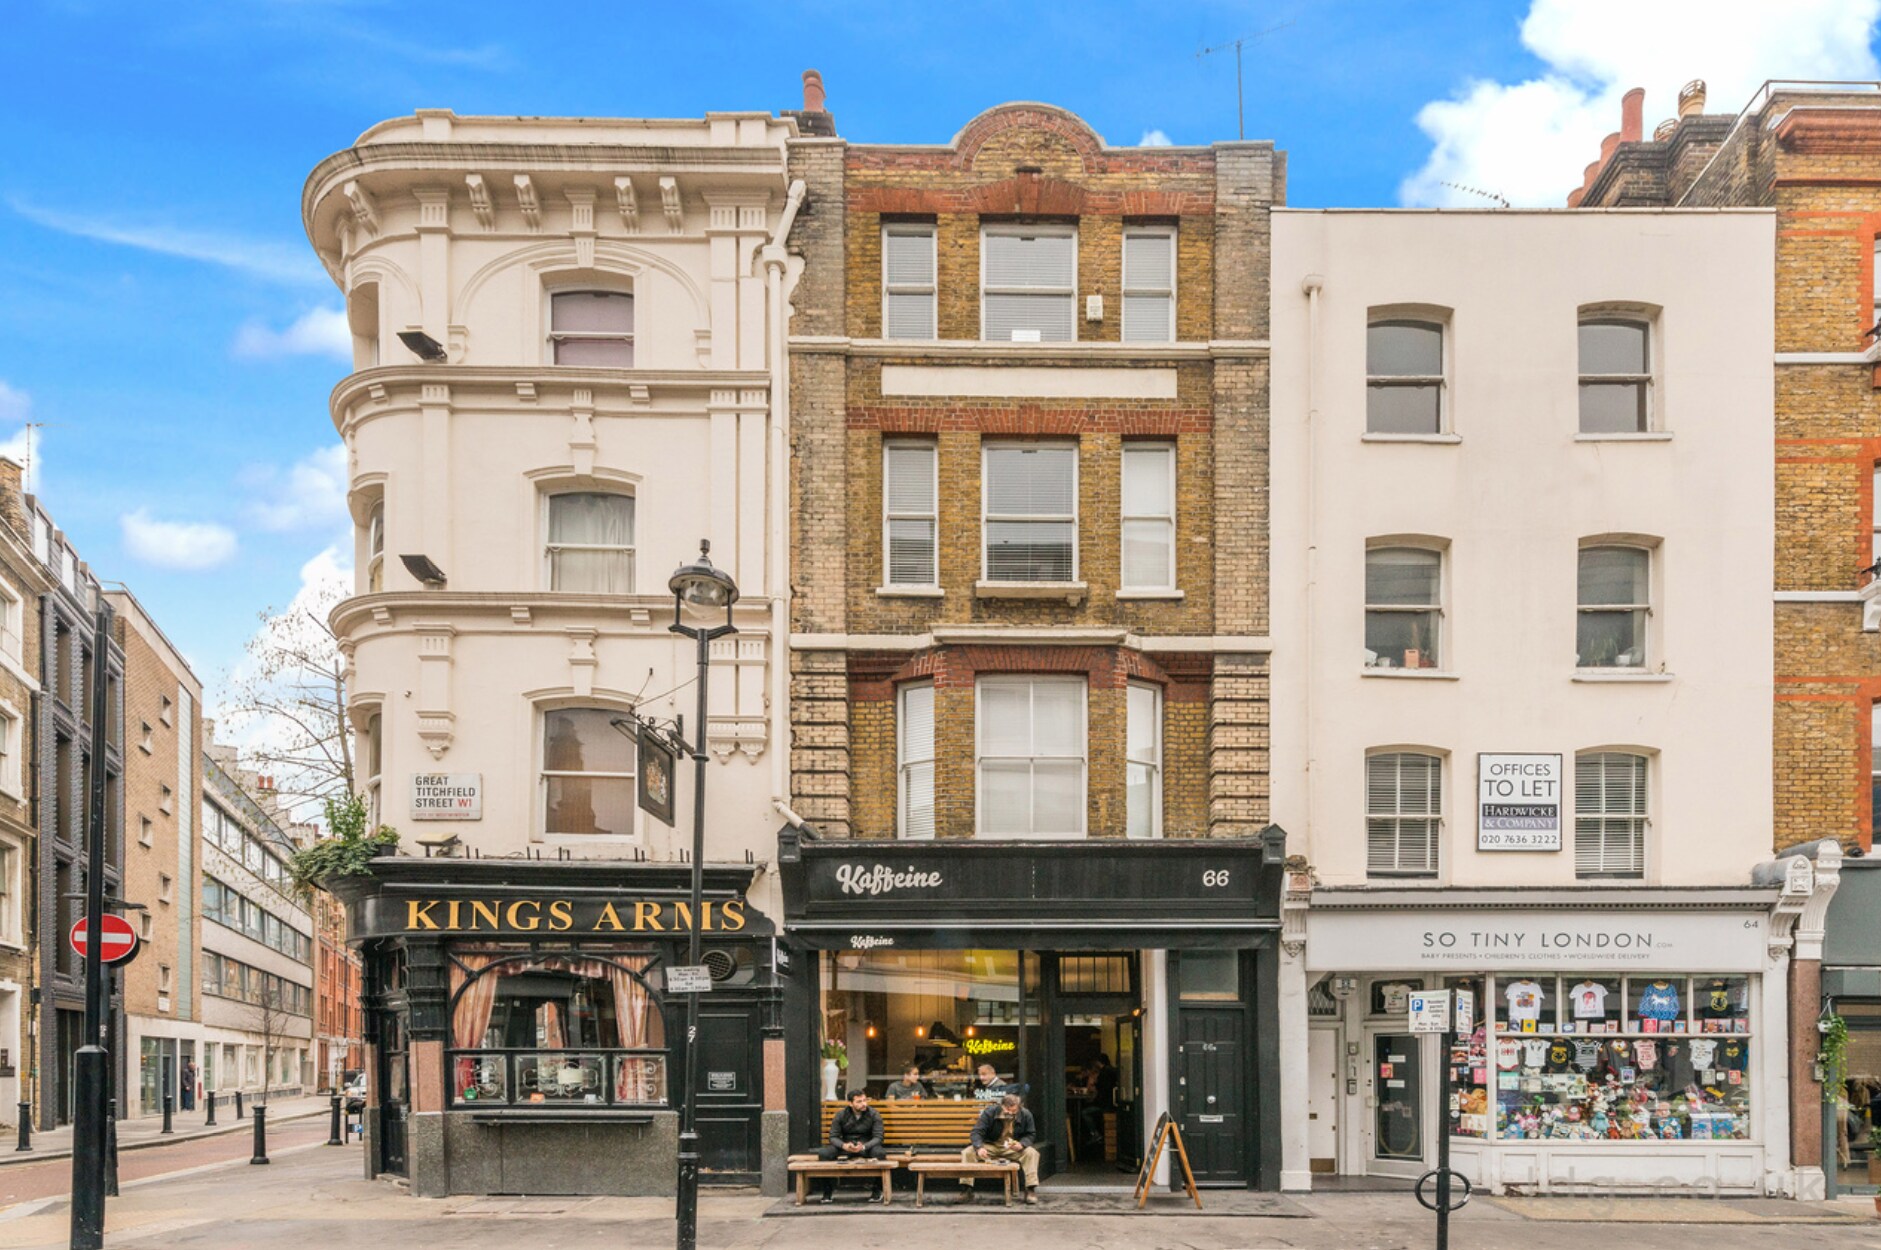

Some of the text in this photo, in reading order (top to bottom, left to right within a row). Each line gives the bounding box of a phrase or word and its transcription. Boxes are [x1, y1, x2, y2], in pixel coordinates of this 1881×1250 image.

[1490, 763, 1551, 776] OFFICES
[415, 775, 449, 786] GREAT
[416, 787, 476, 797] TITCHFIELD
[1484, 779, 1557, 797] TO LET
[415, 798, 472, 808] STREET W1
[1484, 805, 1555, 817] HARDWICKE
[1496, 818, 1554, 829] COMPANY
[1481, 835, 1557, 844] 020 7636 3222
[836, 863, 943, 896] Kaffeine
[1203, 869, 1230, 887] 66
[404, 899, 746, 932] KINGS ARMS
[1743, 919, 1758, 929] 64
[850, 935, 894, 949] Kaffeine
[1423, 932, 1456, 947] SO
[1471, 932, 1526, 947] TINY
[1541, 932, 1652, 948] LONDON
[1420, 952, 1440, 960] BABY
[1442, 952, 1477, 960] PRESENTS
[1528, 952, 1561, 960] CLOTHES
[1618, 952, 1650, 960] DELIVERY
[687, 1025, 697, 1043] 27
[966, 1039, 1015, 1054] Kaffeine
